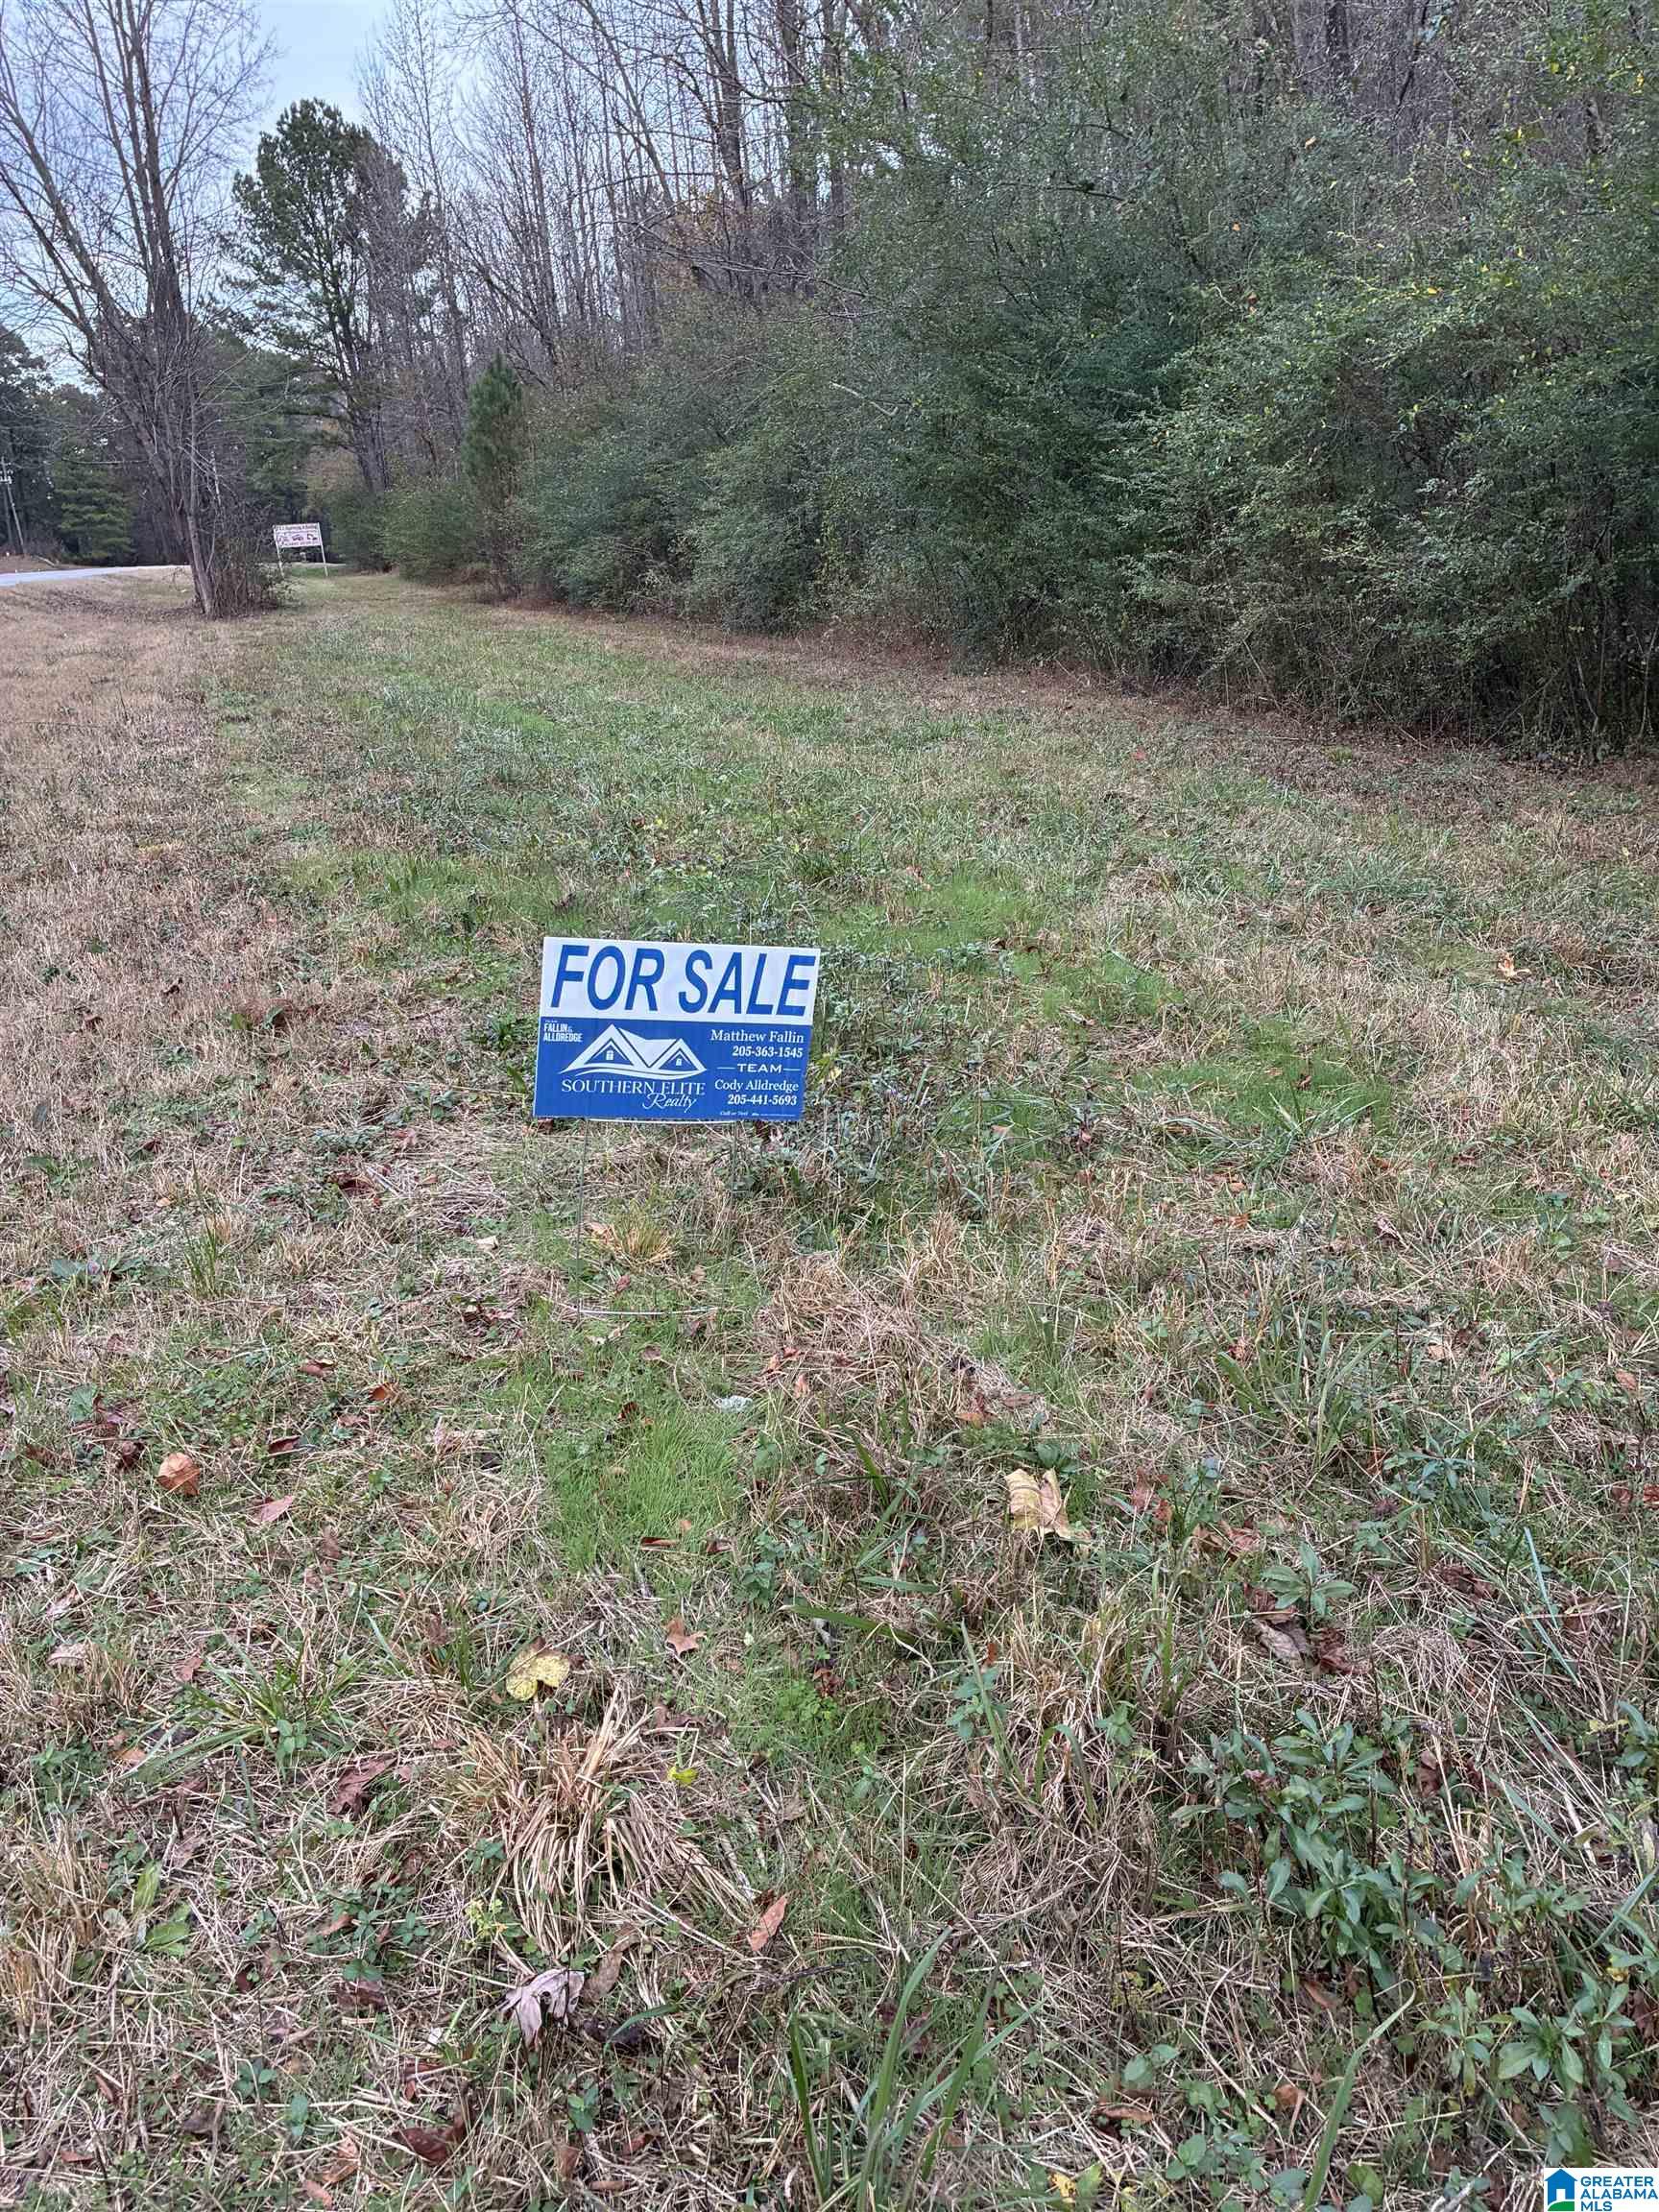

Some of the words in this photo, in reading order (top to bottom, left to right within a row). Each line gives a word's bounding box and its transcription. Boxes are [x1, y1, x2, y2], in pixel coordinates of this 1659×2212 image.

[550, 944, 665, 1012] FOR
[678, 949, 816, 1017] SALE
[544, 1023, 568, 1032] FALLIN
[543, 1032, 584, 1043] ALLDREDGE
[710, 1029, 765, 1042] Matthew
[769, 1030, 805, 1044] Fallin
[732, 1046, 804, 1058] 205-363-1545
[736, 1063, 782, 1073] TEAM
[561, 1078, 655, 1094] SOUTHERN
[661, 1081, 706, 1095] ELITE
[714, 1078, 743, 1093] Cody
[745, 1079, 800, 1094] Alldredge
[642, 1093, 697, 1113] Realty
[727, 1094, 798, 1106] 205-441-5693
